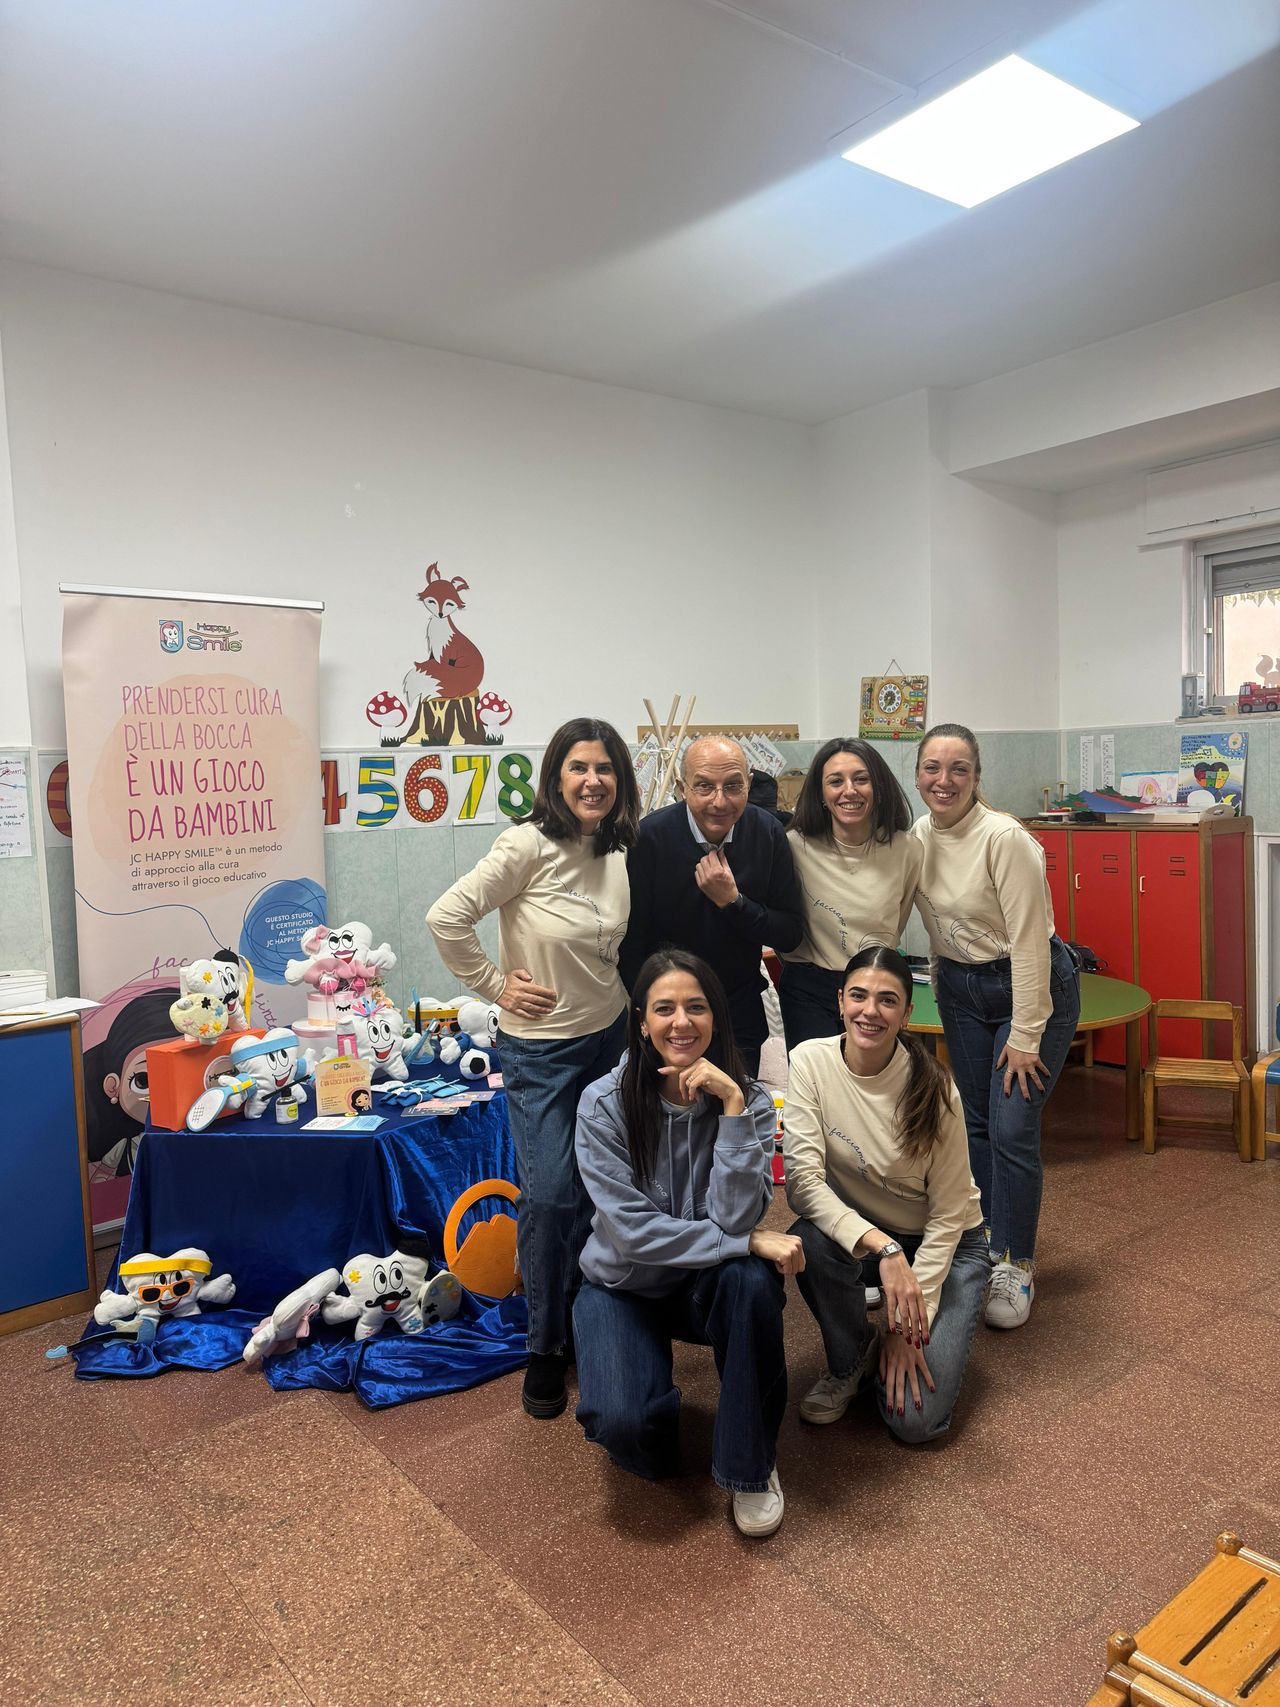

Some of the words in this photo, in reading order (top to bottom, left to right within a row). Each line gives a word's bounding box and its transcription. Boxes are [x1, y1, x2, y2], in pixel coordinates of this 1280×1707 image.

[196, 623, 231, 633] Happy
[122, 686, 228, 716] PRENDERSI
[236, 688, 282, 716] CURA
[124, 722, 186, 752] DELLA
[193, 722, 252, 750] BOCCA
[126, 753, 141, 797] È
[150, 758, 183, 796] UN
[194, 758, 264, 794] GIOCO
[356, 756, 400, 827] 5
[404, 754, 448, 823] 6
[453, 755, 490, 820] 7
[498, 753, 536, 818] 8
[128, 805, 164, 843] DA
[174, 799, 277, 839] BAMBINI
[130, 854, 142, 866] JC
[146, 850, 181, 862] HAPPY
[226, 846, 232, 856] è
[235, 847, 246, 855] un
[250, 843, 282, 854] metodo
[132, 868, 140, 877] di
[144, 864, 195, 878] approccio
[198, 860, 216, 871] alla
[218, 861, 240, 870] cura
[132, 880, 180, 892] attraverso
[183, 876, 189, 886] il
[192, 874, 220, 888] gioco
[224, 870, 267, 882] educativo
[265, 914, 290, 923] QUESTO
[292, 912, 314, 920] STUDIO
[276, 919, 314, 930] CERTIFICATO
[814, 899, 846, 928] facciamo
[288, 927, 312, 935] METOD
[266, 940, 274, 948] JC
[829, 1127, 866, 1165] facciamo
